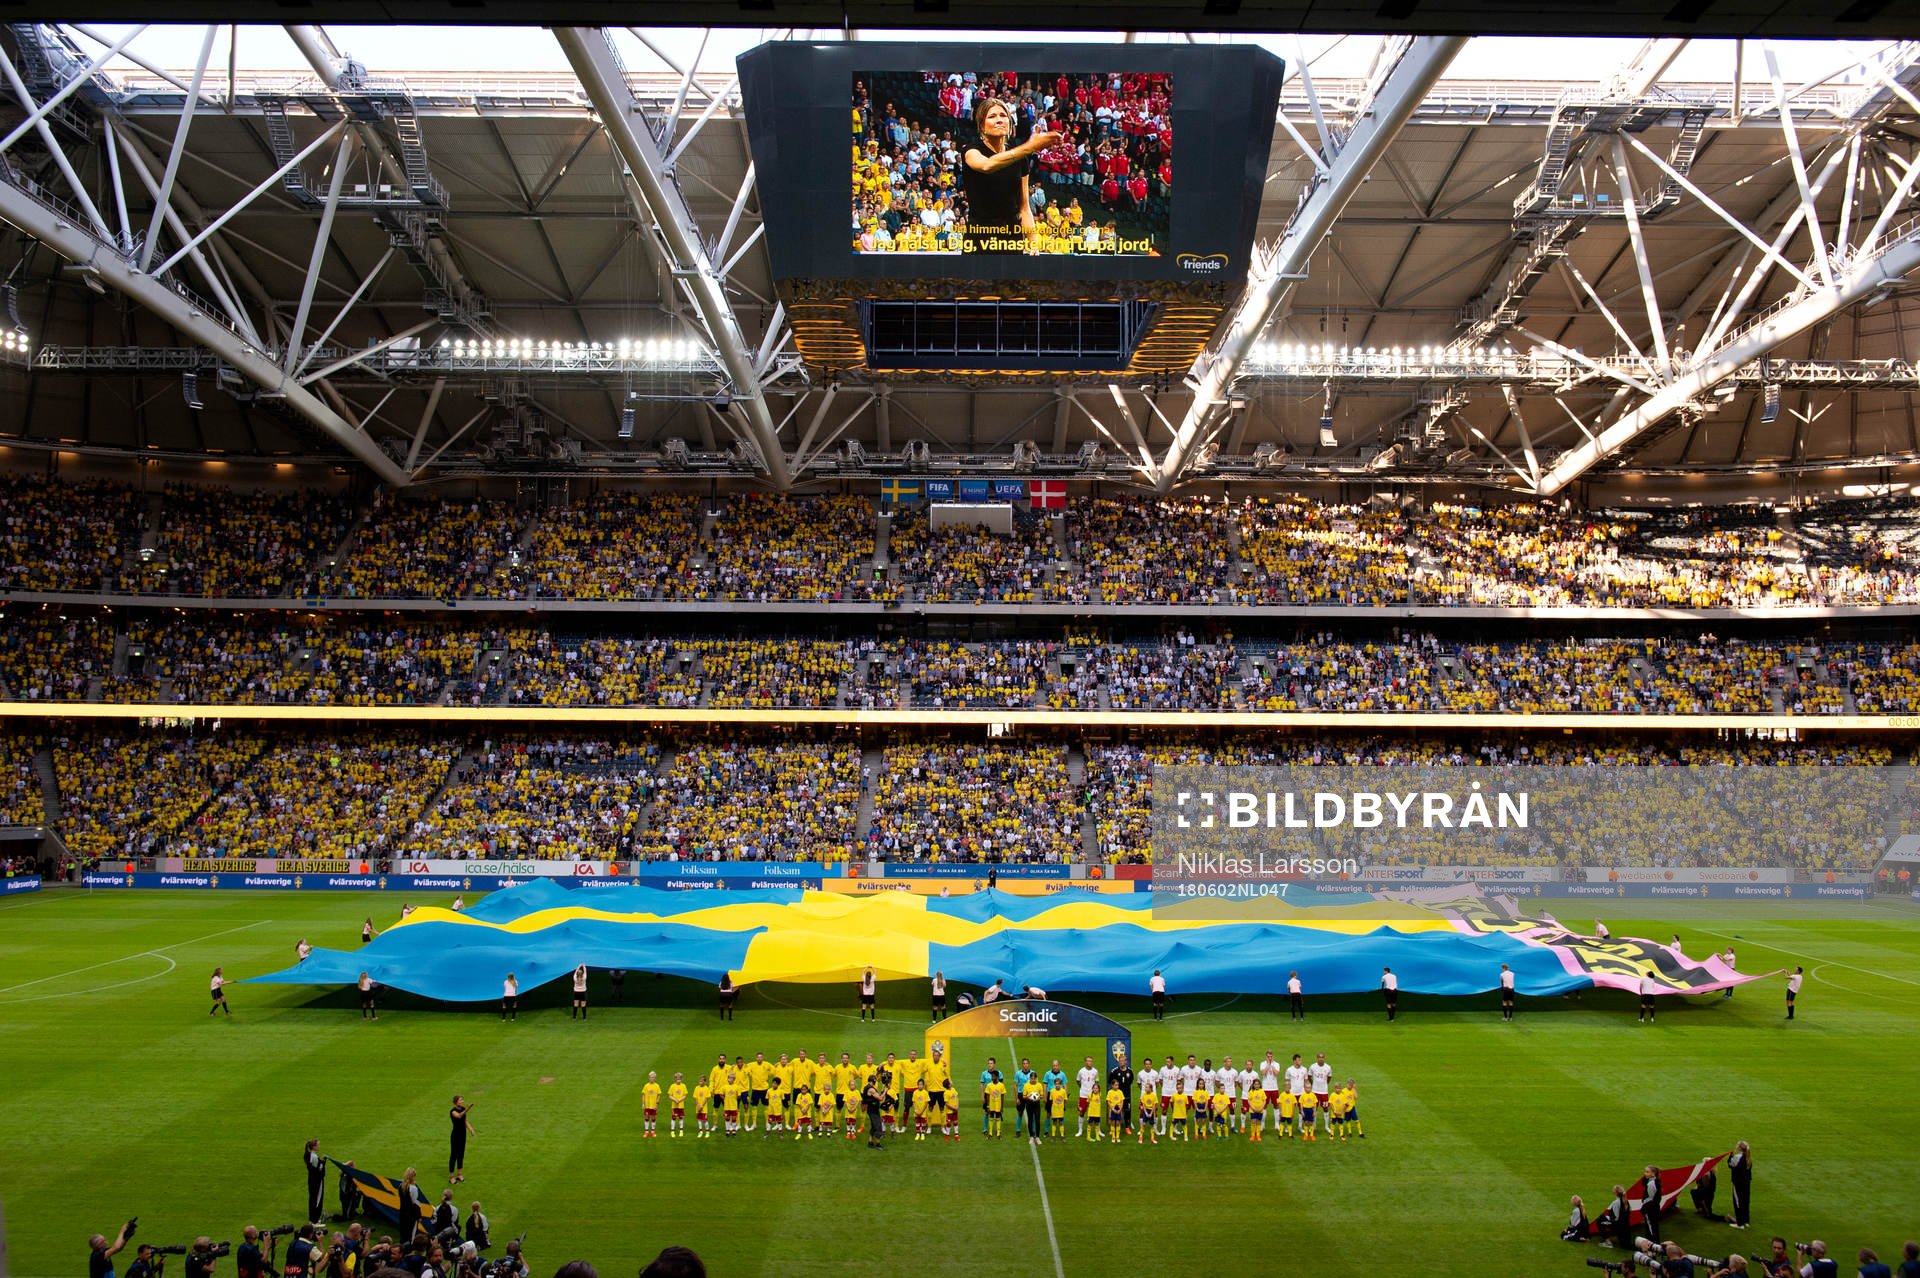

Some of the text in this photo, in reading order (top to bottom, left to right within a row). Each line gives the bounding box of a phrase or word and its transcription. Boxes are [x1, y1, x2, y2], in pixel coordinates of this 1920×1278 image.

[969, 224, 1012, 235] himmel,
[870, 237, 896, 251] Jag
[948, 237, 977, 252] Dig,
[980, 237, 1040, 251] vänaste
[1117, 236, 1152, 253] jord,
[1184, 258, 1220, 269] friends
[995, 485, 1022, 494] UEFA
[183, 860, 257, 873] HEJA SVERIGE
[277, 860, 351, 873] HEJA SVERIGE
[409, 862, 430, 873] ICA
[465, 862, 535, 874] ica.se/hälsa
[574, 864, 595, 875] ICA
[681, 865, 718, 874] Folksam
[764, 866, 800, 875] Folksam
[1364, 870, 1424, 879] INTERSPORT
[1700, 870, 1746, 880] Swedbank
[1000, 1009, 1057, 1022] Scandic
